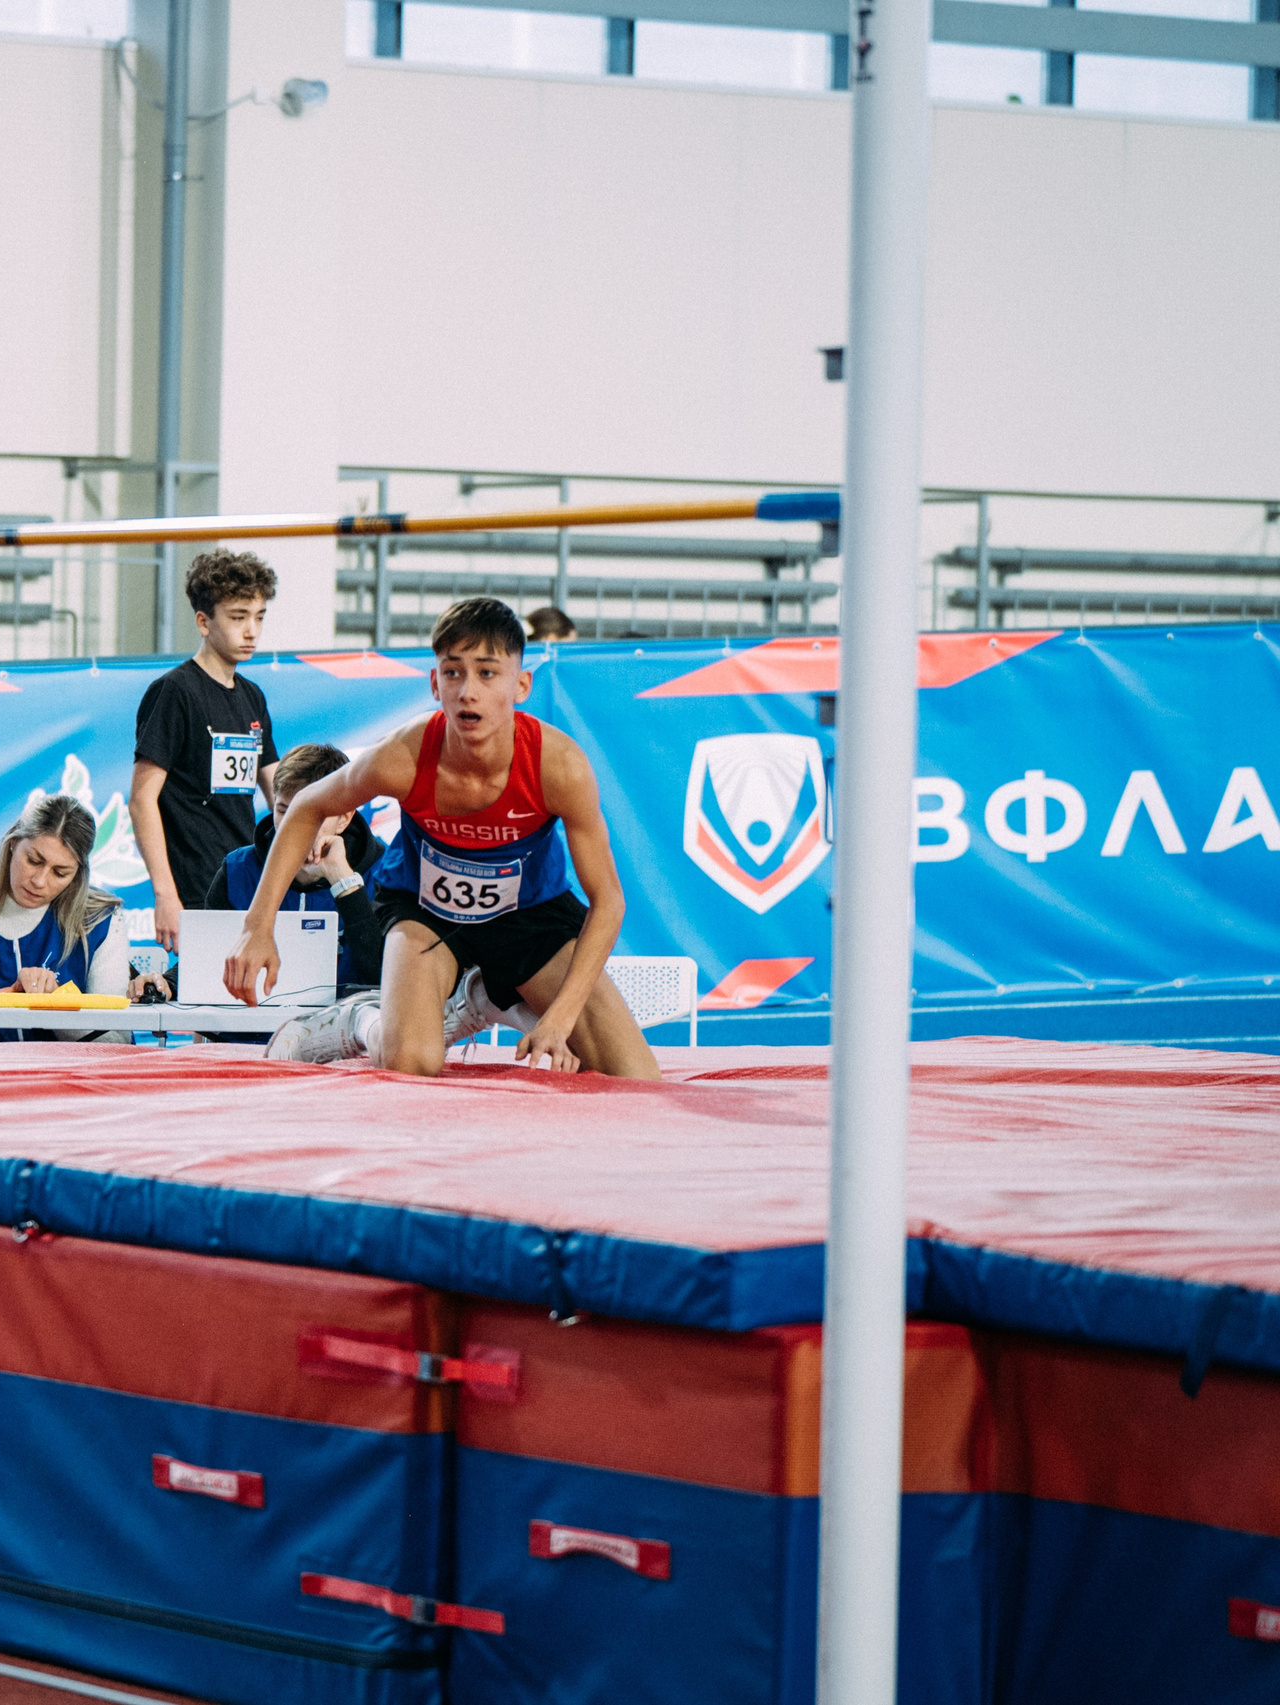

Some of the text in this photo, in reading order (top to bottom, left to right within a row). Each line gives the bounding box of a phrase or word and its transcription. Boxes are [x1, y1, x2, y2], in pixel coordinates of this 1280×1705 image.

[424, 819, 520, 841] RUSSIA
[911, 765, 1280, 863] ВФЛА
[433, 876, 500, 909] 635
